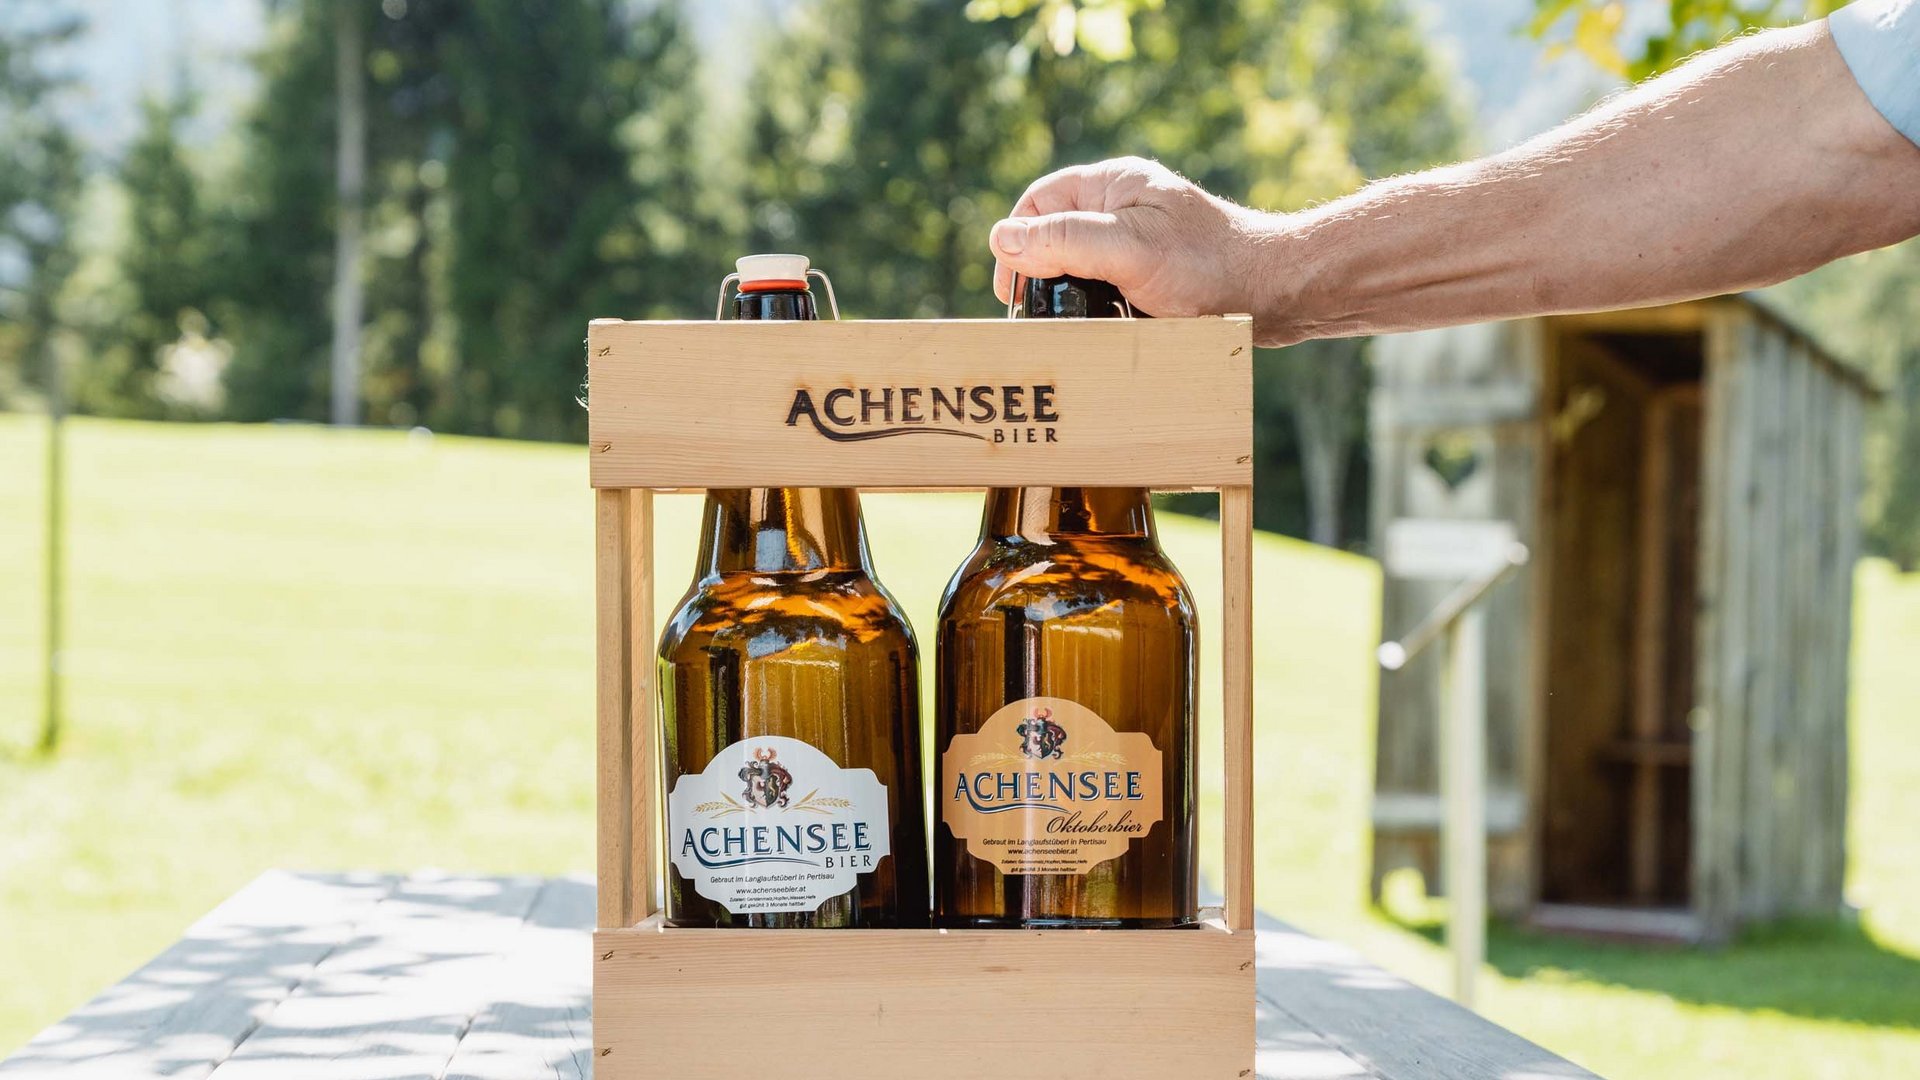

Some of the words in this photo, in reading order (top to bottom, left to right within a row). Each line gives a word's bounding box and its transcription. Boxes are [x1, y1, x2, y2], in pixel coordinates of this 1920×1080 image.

[785, 385, 1059, 428] ACHENSEE
[994, 428, 1059, 443] BIER
[954, 771, 1144, 802] ACHENSEE
[1046, 810, 1144, 835] Oktoberbier
[681, 822, 872, 858] ACHENSEE
[982, 838, 1006, 846] Gebraut
[1007, 838, 1016, 846] im
[826, 855, 872, 869] BIER
[710, 876, 734, 884] Gebraut
[735, 875, 744, 883] im
[745, 873, 797, 884] Langlaufstüberl
[798, 873, 805, 881] in
[806, 873, 835, 881] Pertisau
[736, 885, 806, 894] www.achenseebier.at
